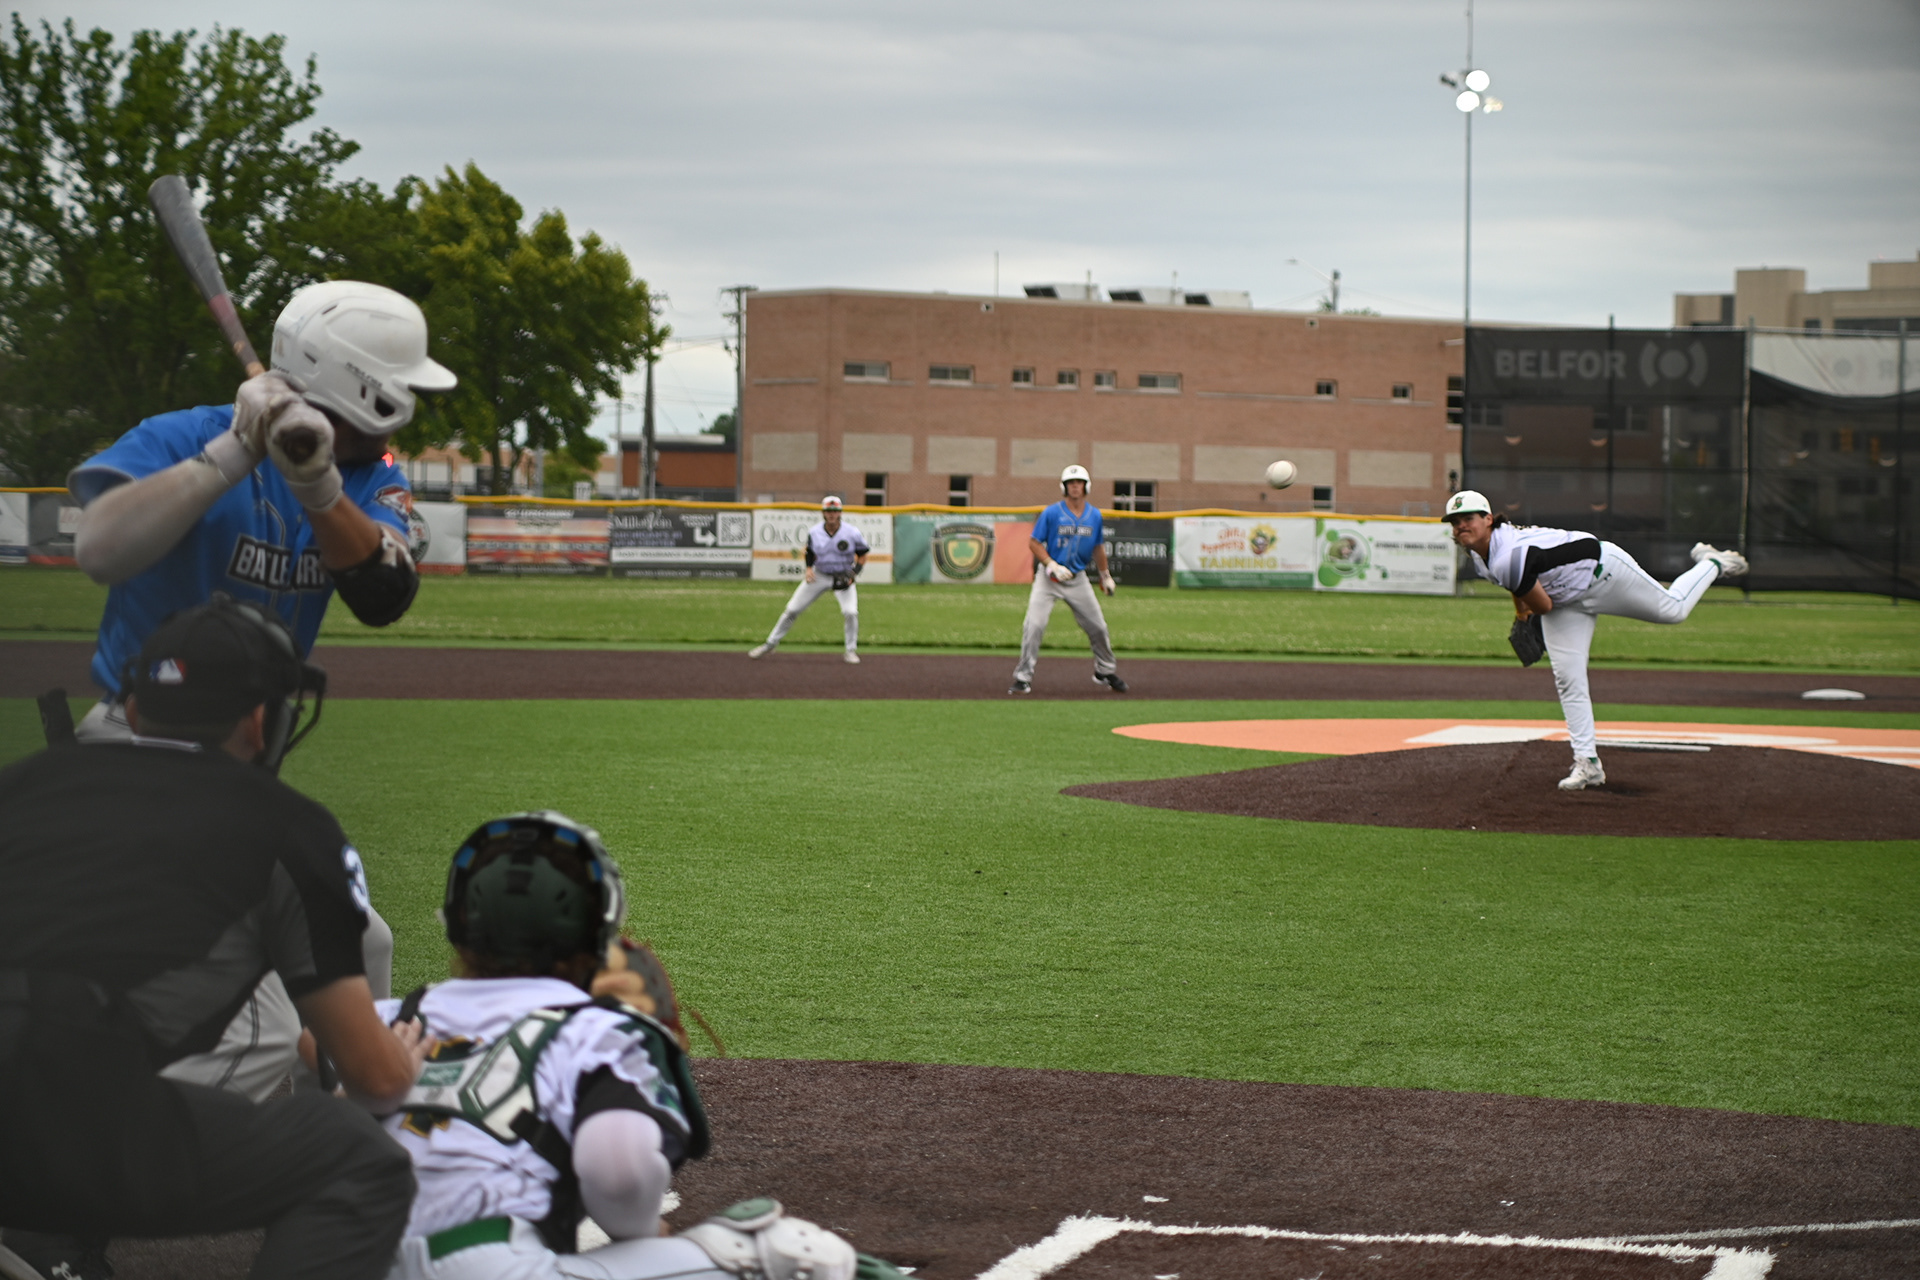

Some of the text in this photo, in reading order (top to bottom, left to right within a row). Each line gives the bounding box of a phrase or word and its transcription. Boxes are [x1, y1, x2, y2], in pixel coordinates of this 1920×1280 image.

[1495, 350, 1627, 379] BELFOR
[1115, 542, 1167, 559] CORNER
[1199, 556, 1278, 569] TANNING
